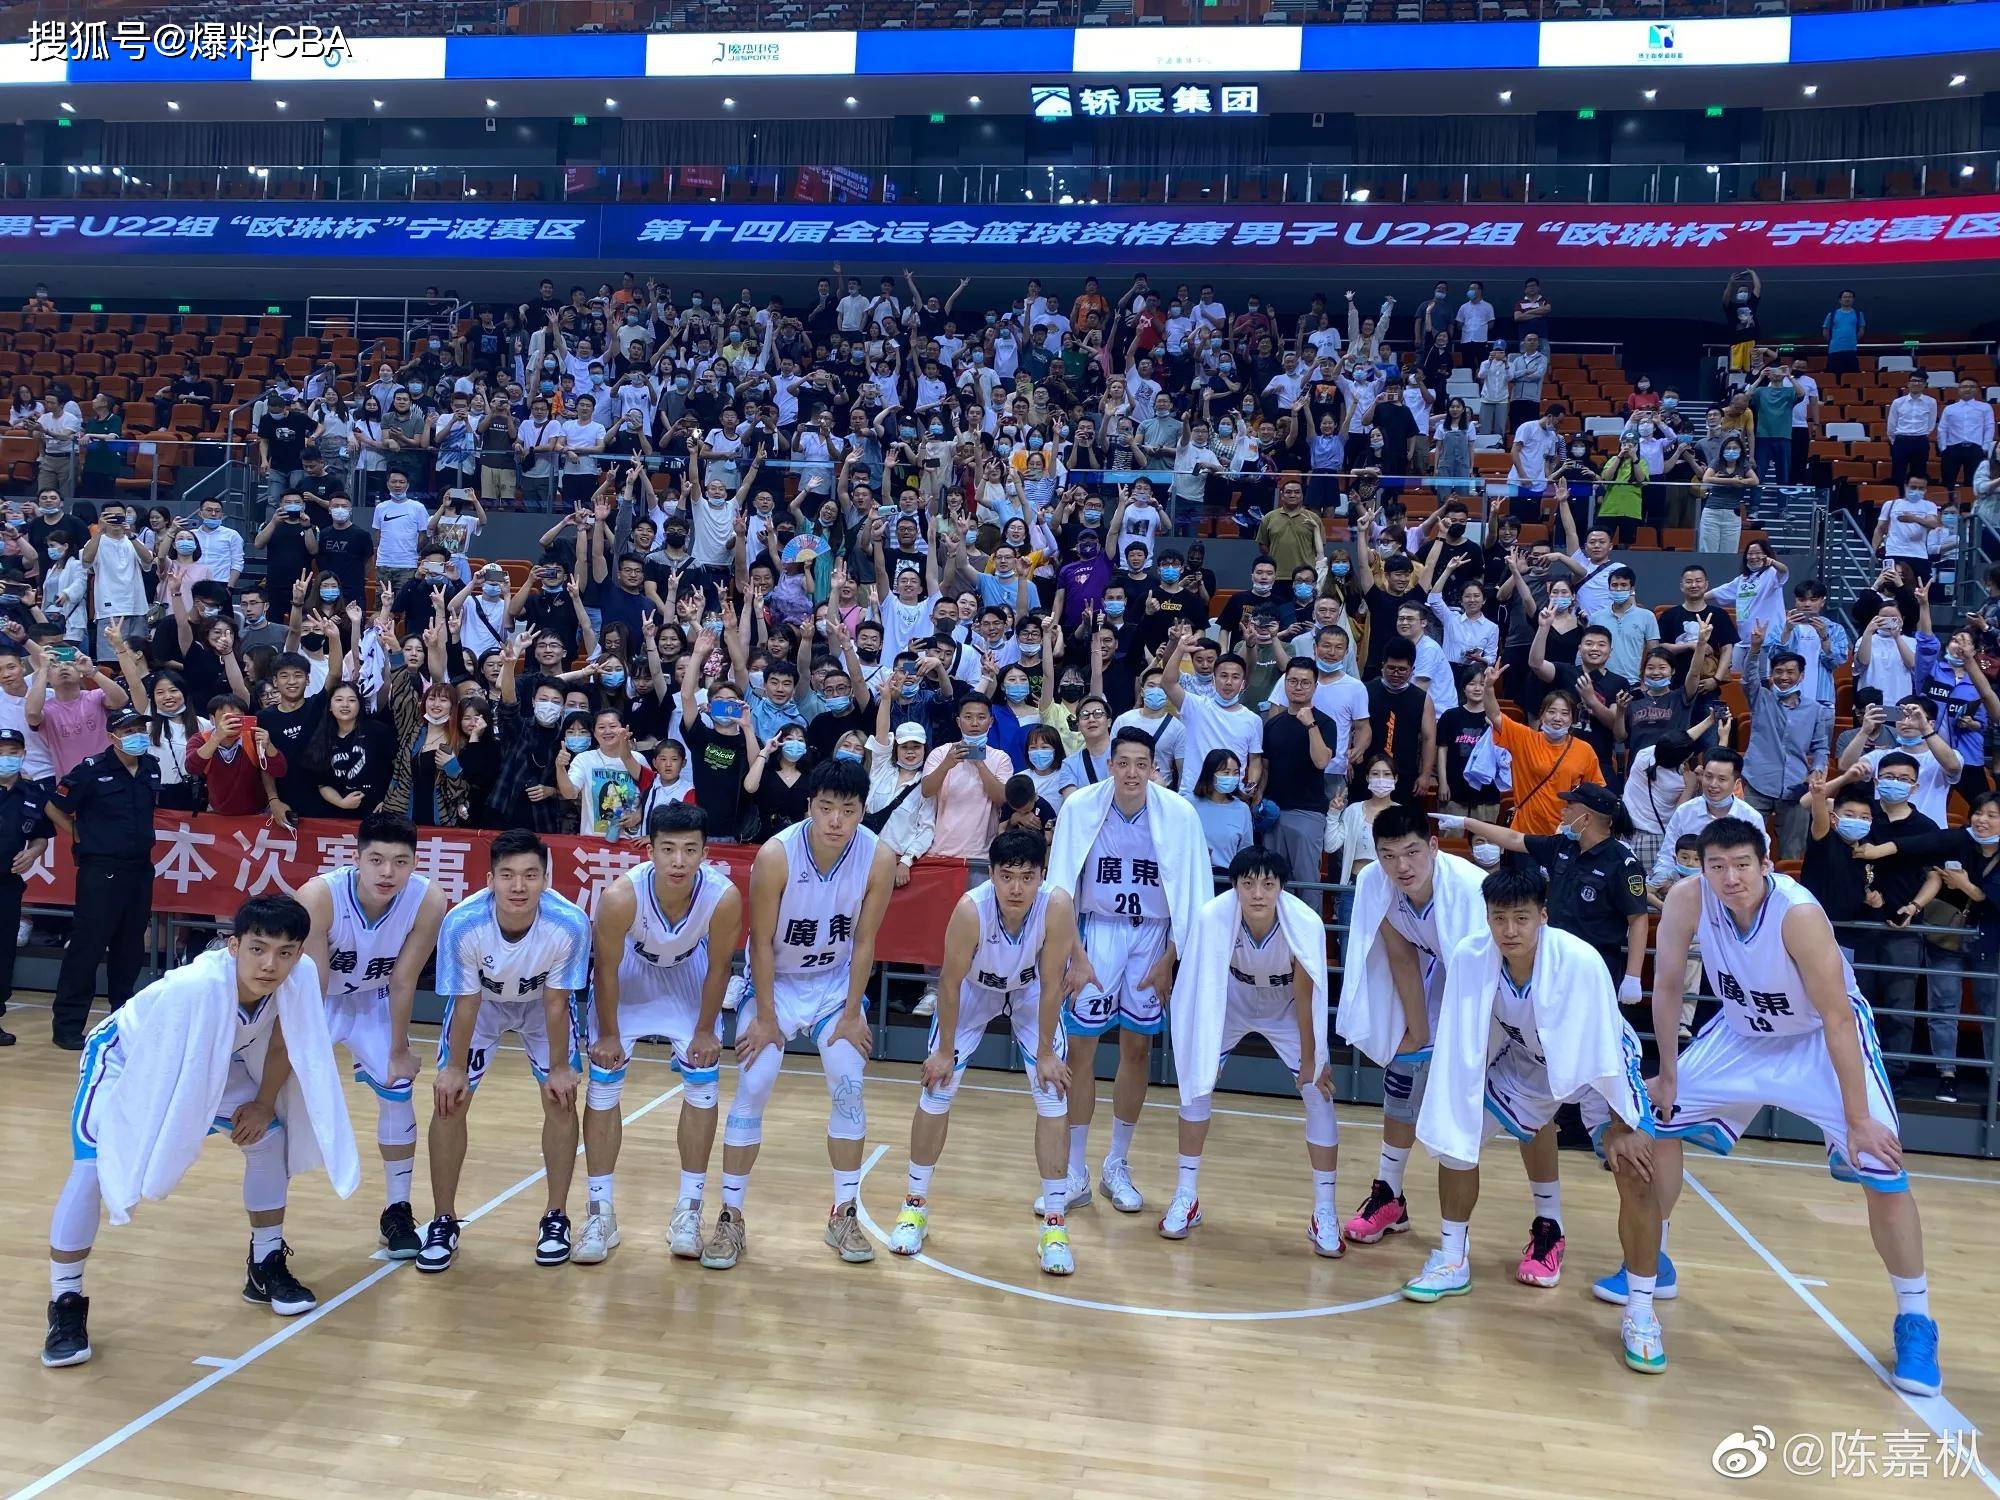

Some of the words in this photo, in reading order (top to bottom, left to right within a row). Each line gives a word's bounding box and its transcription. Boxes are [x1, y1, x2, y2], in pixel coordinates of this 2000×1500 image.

[1079, 86, 1259, 116] 轿辰集团
[1096, 857, 1160, 887] 廣東
[1114, 893, 1142, 916] 28
[784, 914, 851, 946] 廣東
[800, 952, 836, 968] 25
